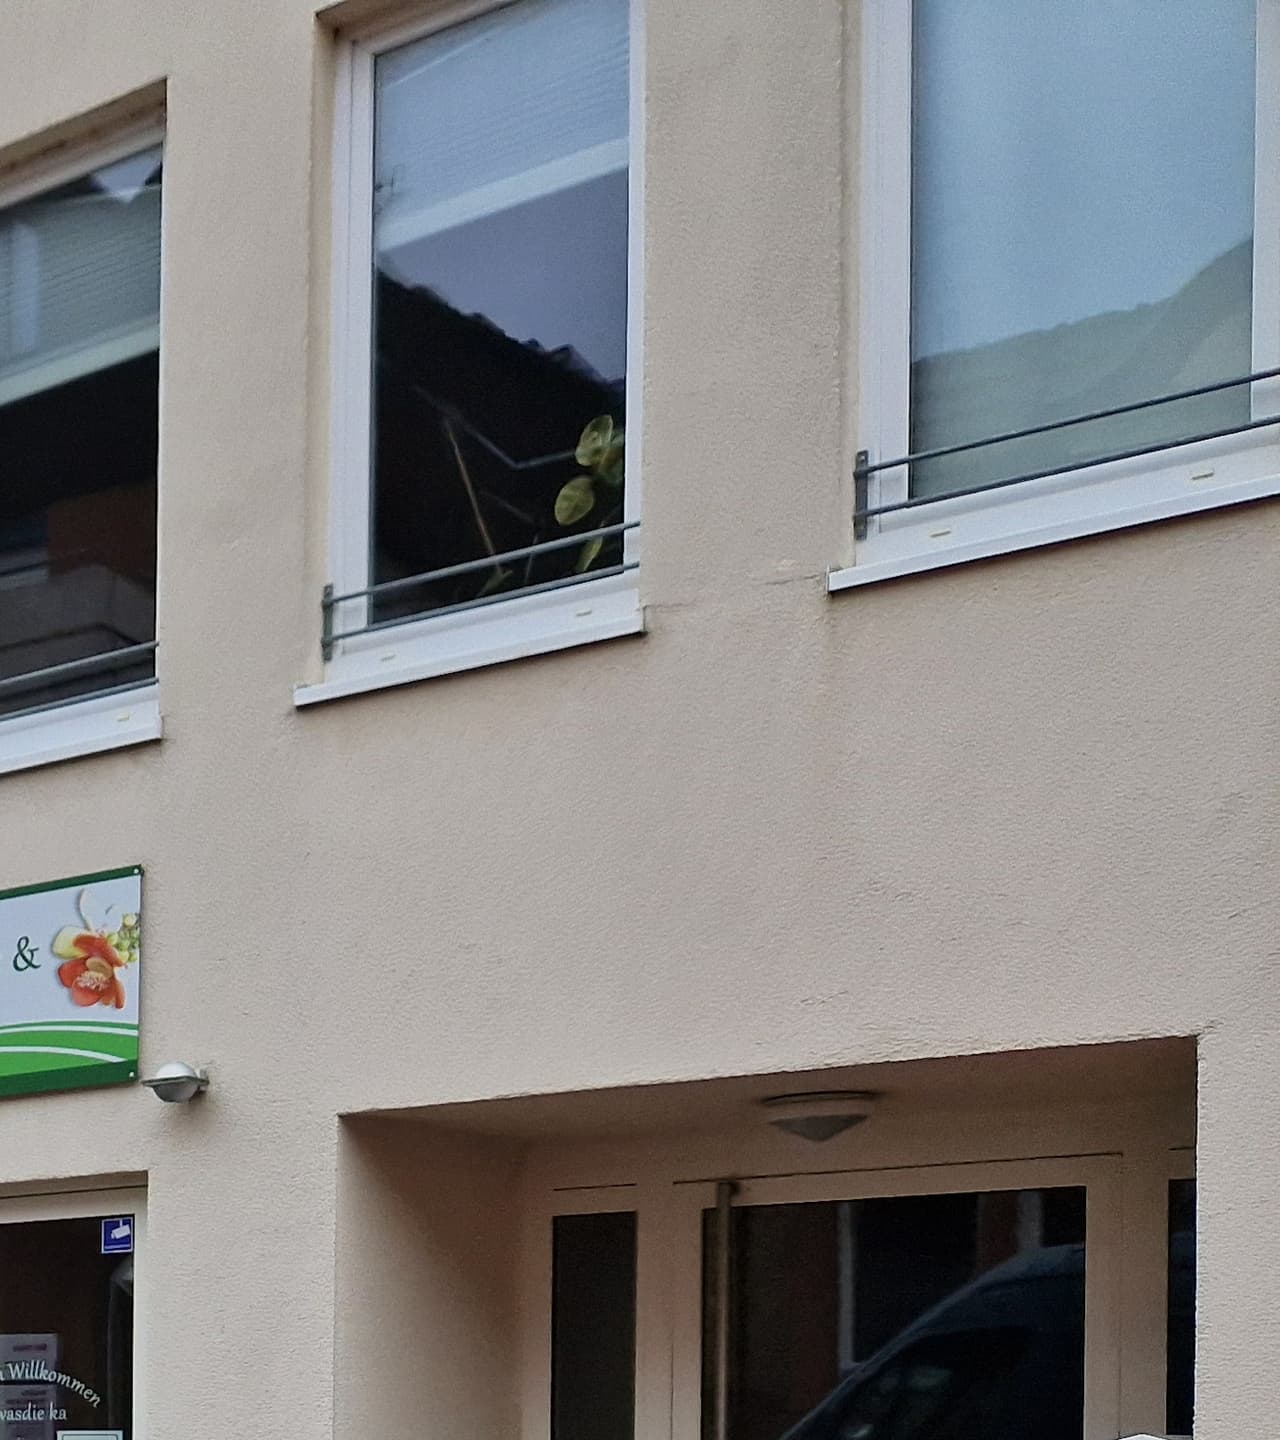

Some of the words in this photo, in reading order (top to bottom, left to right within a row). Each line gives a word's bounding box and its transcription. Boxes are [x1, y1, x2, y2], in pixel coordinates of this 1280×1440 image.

[12, 935, 42, 972] &
[7, 1359, 102, 1409] Willkommen
[49, 1401, 68, 1420] ka
